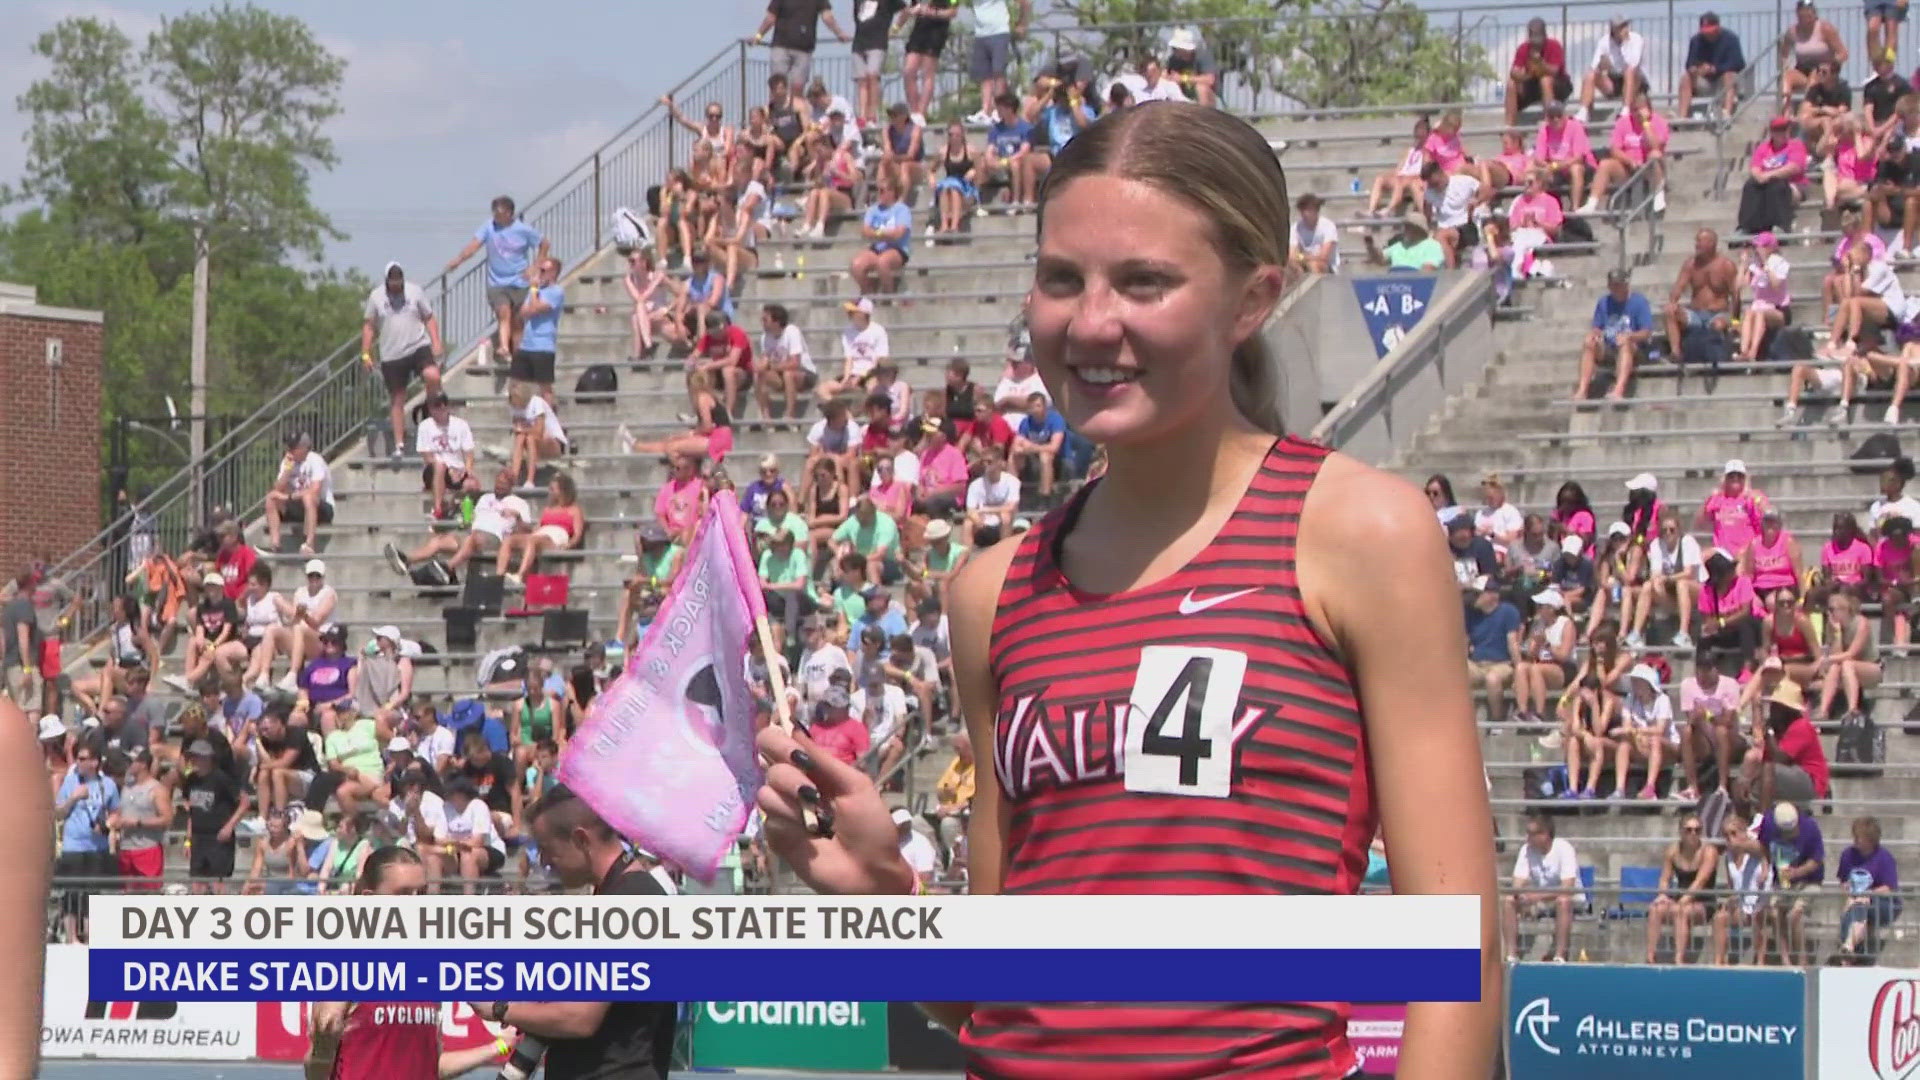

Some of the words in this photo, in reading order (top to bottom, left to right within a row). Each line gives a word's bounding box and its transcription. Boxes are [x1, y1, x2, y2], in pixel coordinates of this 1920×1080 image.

[1374, 294, 1390, 316] A
[1402, 293, 1413, 314] B
[1142, 656, 1213, 786] 4
[41, 1027, 84, 1043] OWA
[90, 1028, 148, 1044] FARM
[152, 1029, 241, 1046] BUREAU
[1576, 1014, 1680, 1041] AHLERS
[1686, 1018, 1798, 1045] COONEY
[1577, 1043, 1693, 1058] ATTORNEYS
